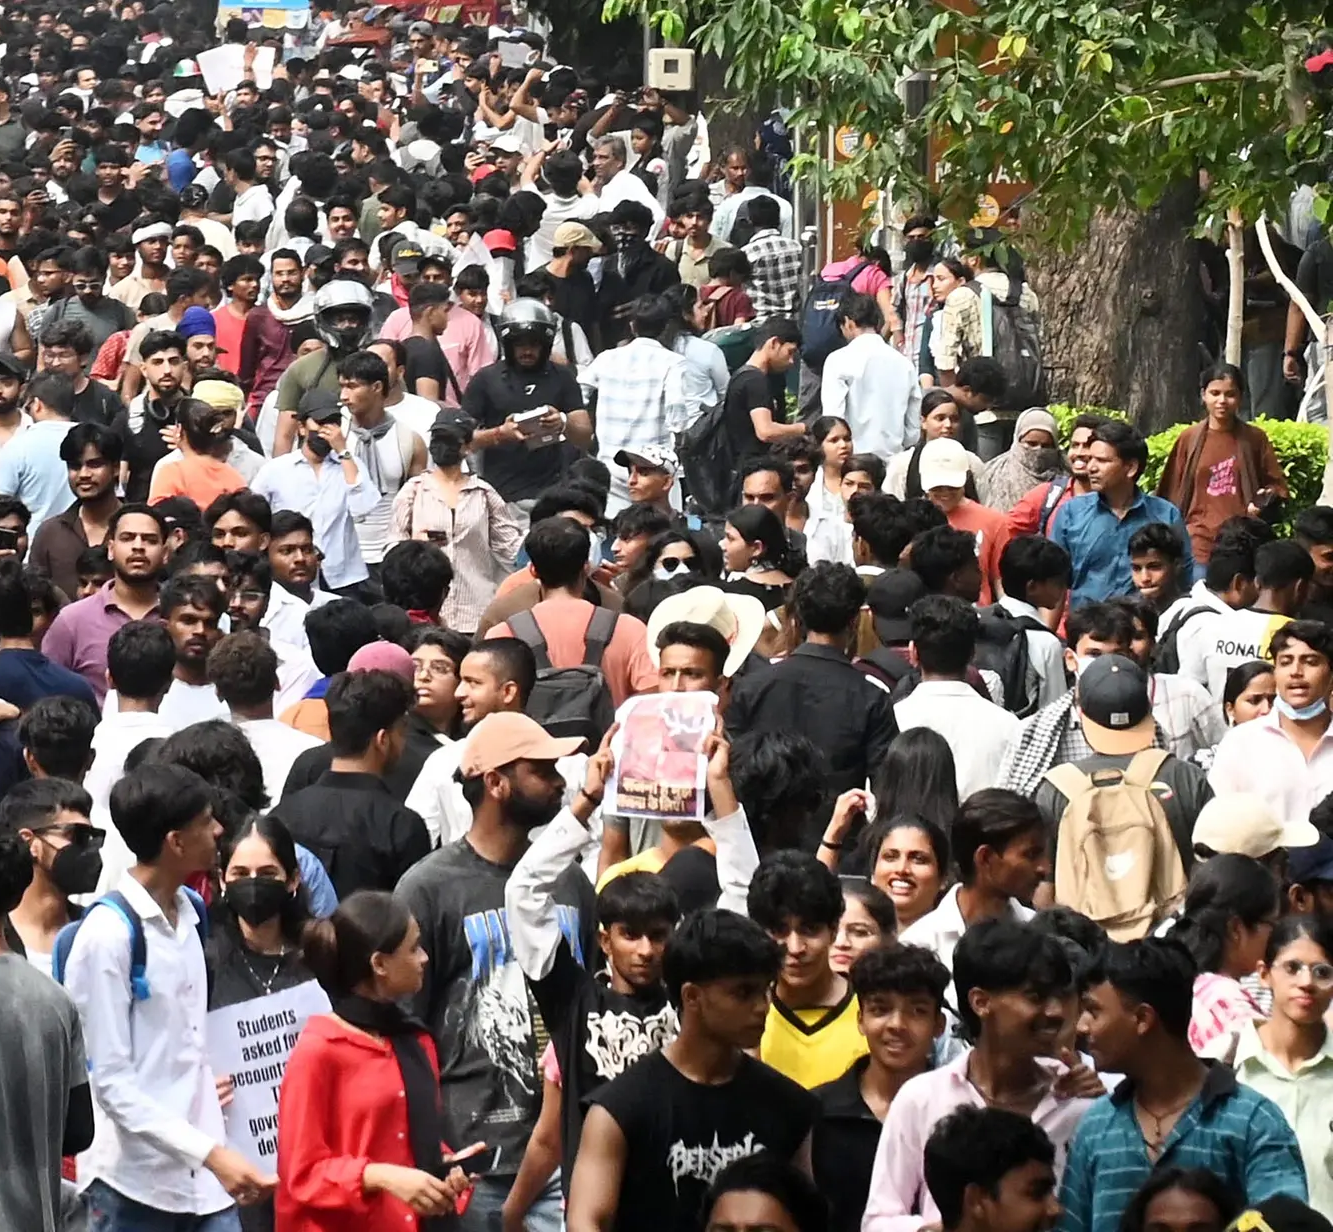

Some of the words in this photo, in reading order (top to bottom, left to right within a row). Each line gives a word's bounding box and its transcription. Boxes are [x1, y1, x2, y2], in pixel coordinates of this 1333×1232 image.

[236, 1009, 297, 1039] Students
[242, 1035, 282, 1062] asked
[283, 1031, 300, 1052] for
